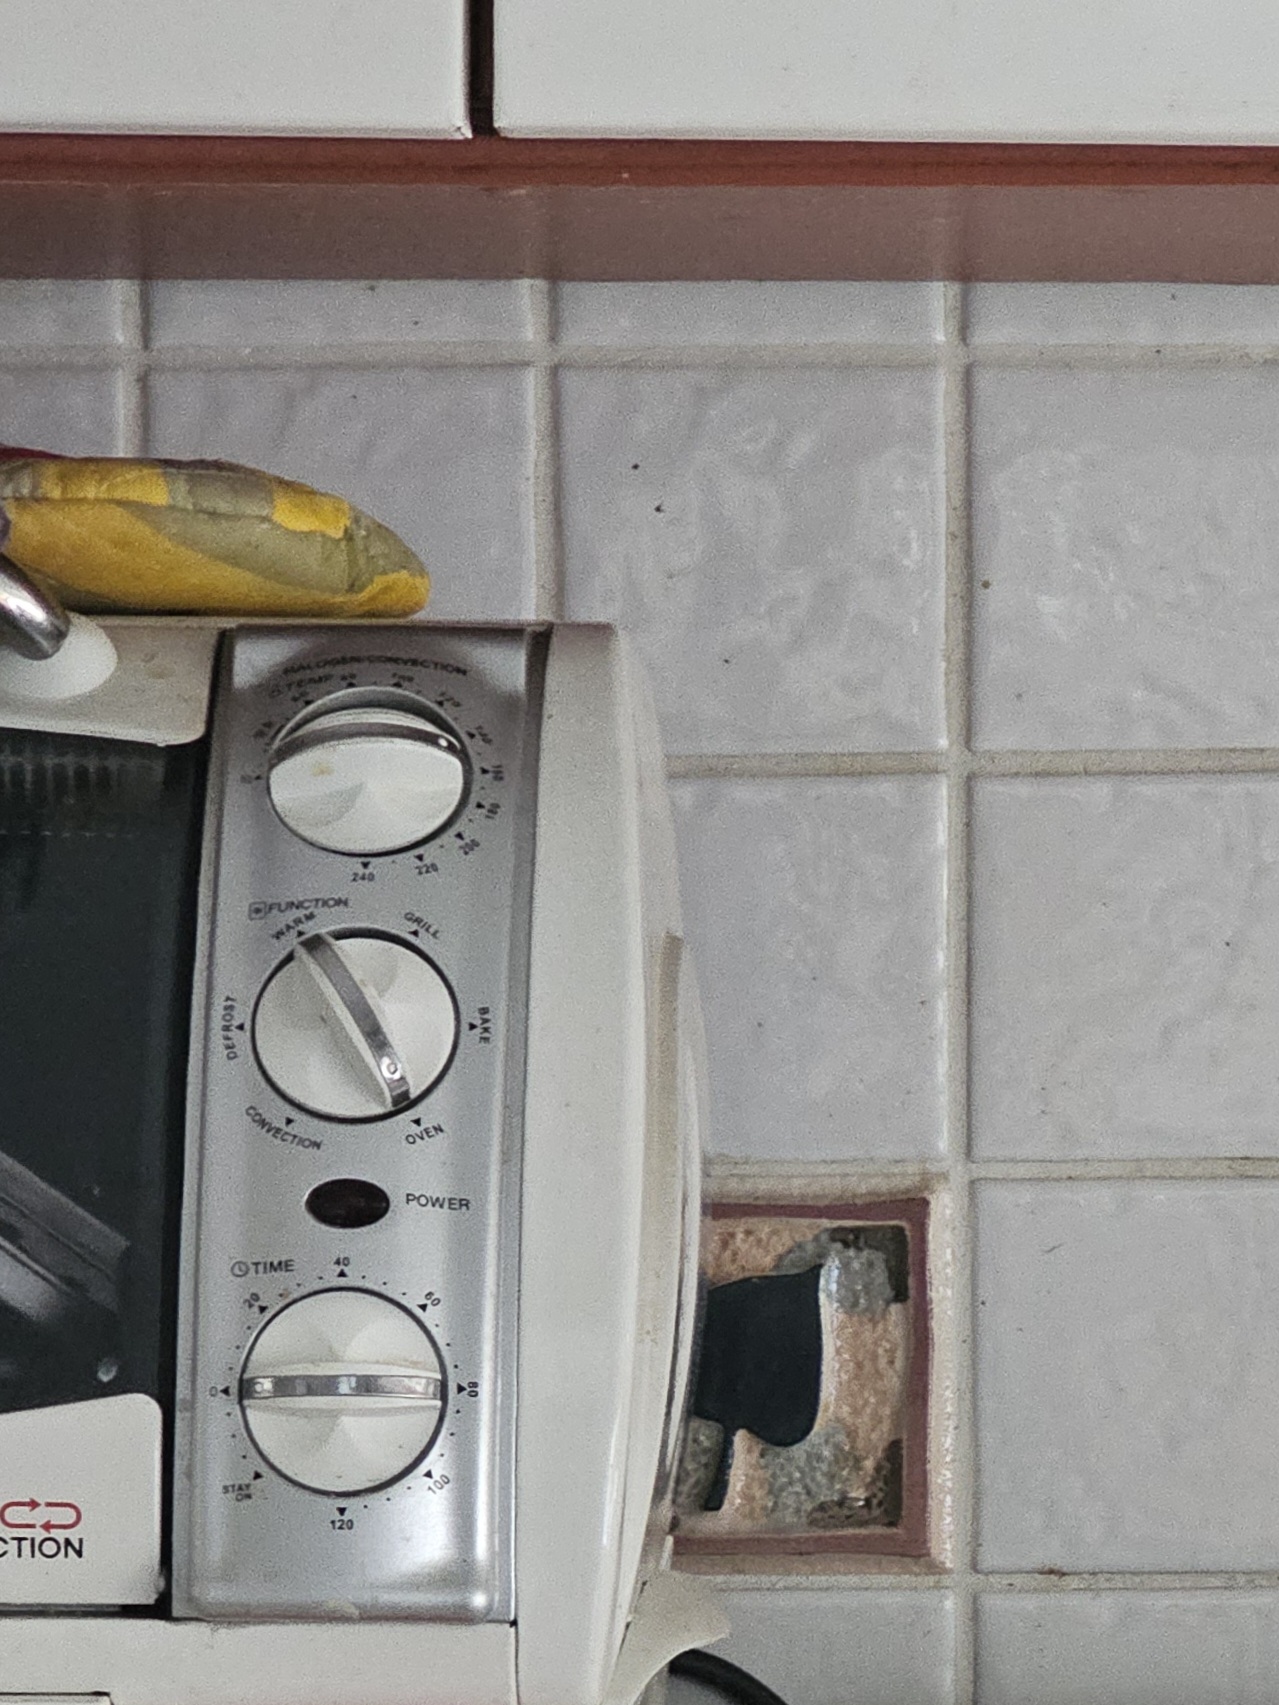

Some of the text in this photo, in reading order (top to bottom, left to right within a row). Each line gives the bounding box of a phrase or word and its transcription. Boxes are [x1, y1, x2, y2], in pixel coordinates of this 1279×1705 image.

[351, 872, 375, 882] 240
[416, 863, 439, 875] 220
[268, 897, 349, 914] FUNCTION
[271, 911, 316, 940] WARM
[404, 912, 442, 940] GRILL
[222, 996, 238, 1061] DEFROST
[478, 1006, 491, 1044] BAKE
[245, 1106, 324, 1151] CONVECTION
[405, 1124, 445, 1145] OVEN
[406, 1193, 471, 1211] POWER
[252, 1259, 295, 1274] TIME
[334, 1257, 350, 1267] 40
[243, 1292, 261, 1309] 20
[424, 1291, 441, 1308] 60
[468, 1381, 479, 1398] 80
[427, 1474, 451, 1494] 100
[330, 1519, 353, 1530] 120
